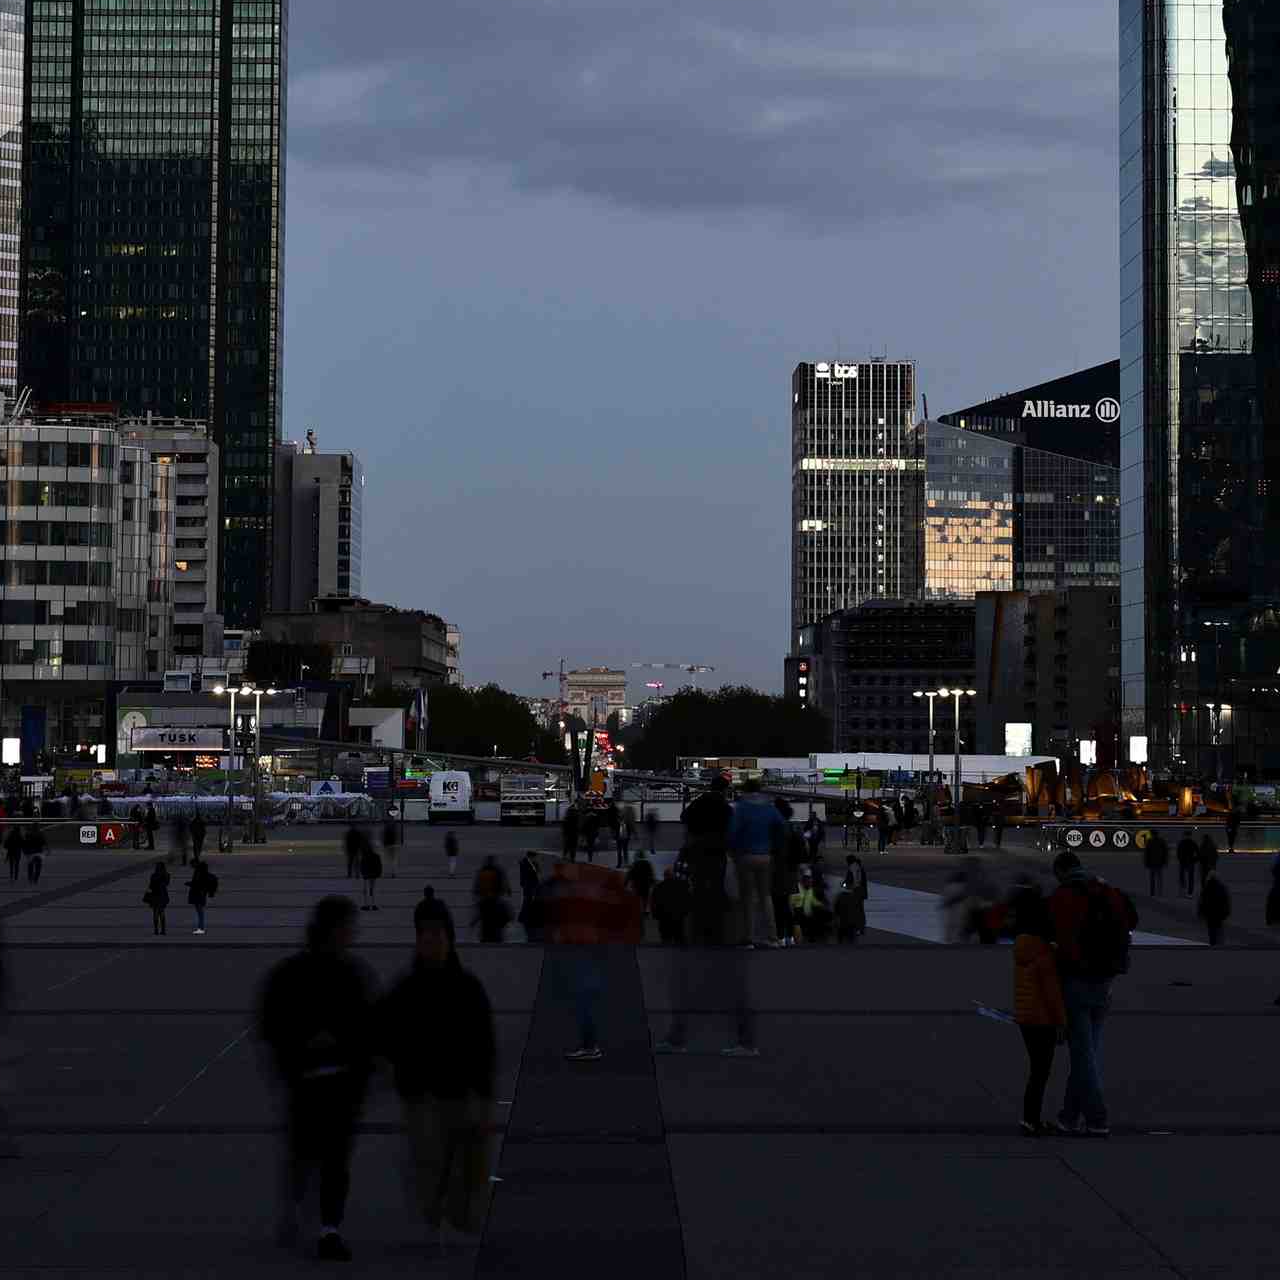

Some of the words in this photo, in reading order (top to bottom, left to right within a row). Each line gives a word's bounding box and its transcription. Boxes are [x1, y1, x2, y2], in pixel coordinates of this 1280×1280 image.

[1021, 400, 1091, 418] Allianz
[159, 733, 198, 743] TUSK
[105, 828, 116, 841] A
